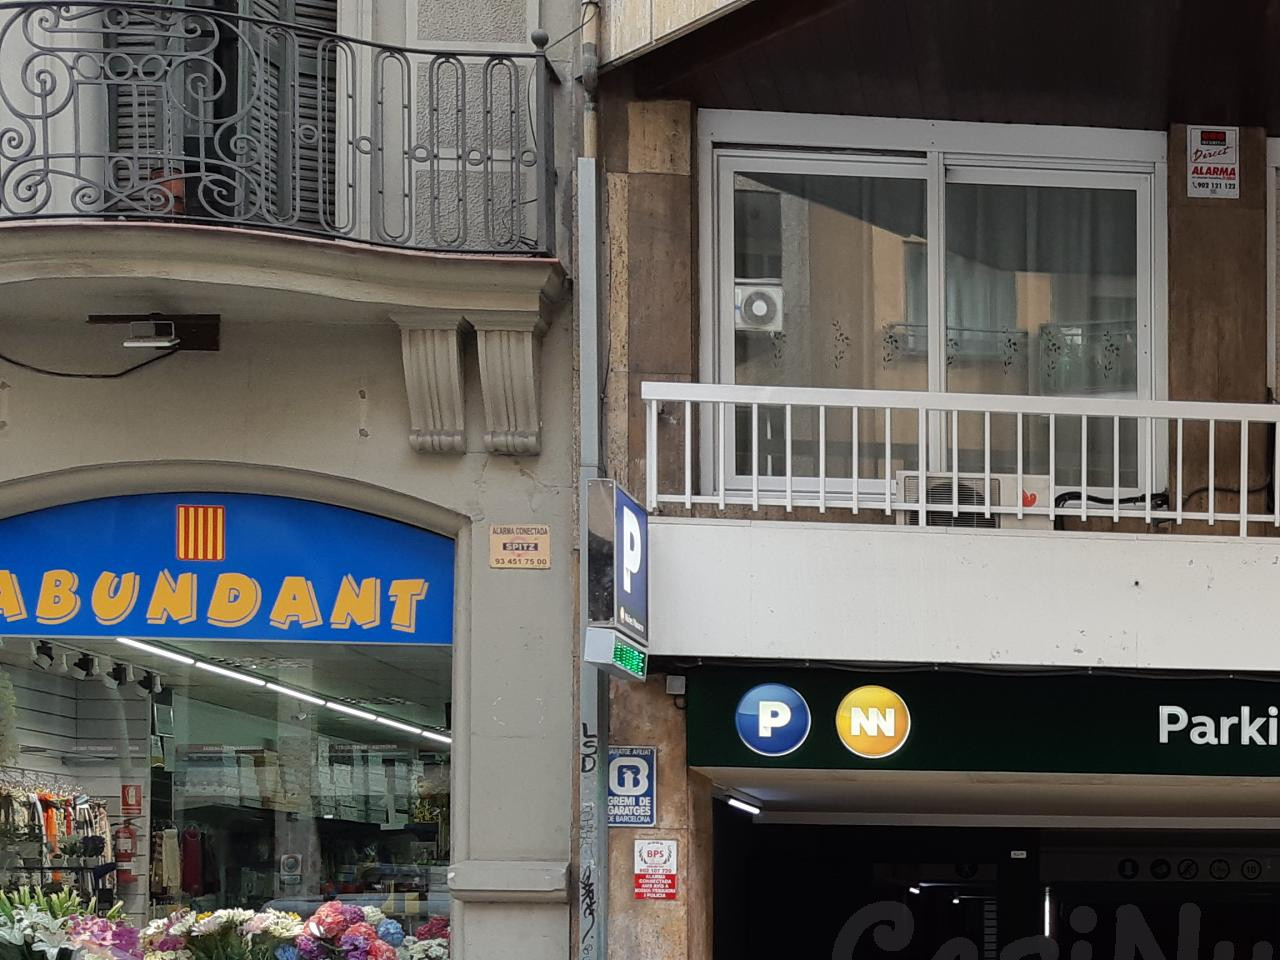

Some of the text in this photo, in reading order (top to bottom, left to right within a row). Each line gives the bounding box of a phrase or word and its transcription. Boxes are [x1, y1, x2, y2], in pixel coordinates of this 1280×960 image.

[1192, 166, 1236, 176] ALARMA
[493, 527, 515, 535] ALARMA
[505, 543, 536, 551] SPITZ
[623, 505, 642, 594] P
[758, 701, 792, 738] P
[850, 707, 895, 737] NN
[608, 796, 652, 806] GREMI DE
[608, 806, 652, 816] GARATGES
[615, 815, 651, 823] BARCELONA
[647, 850, 664, 858] BPS
